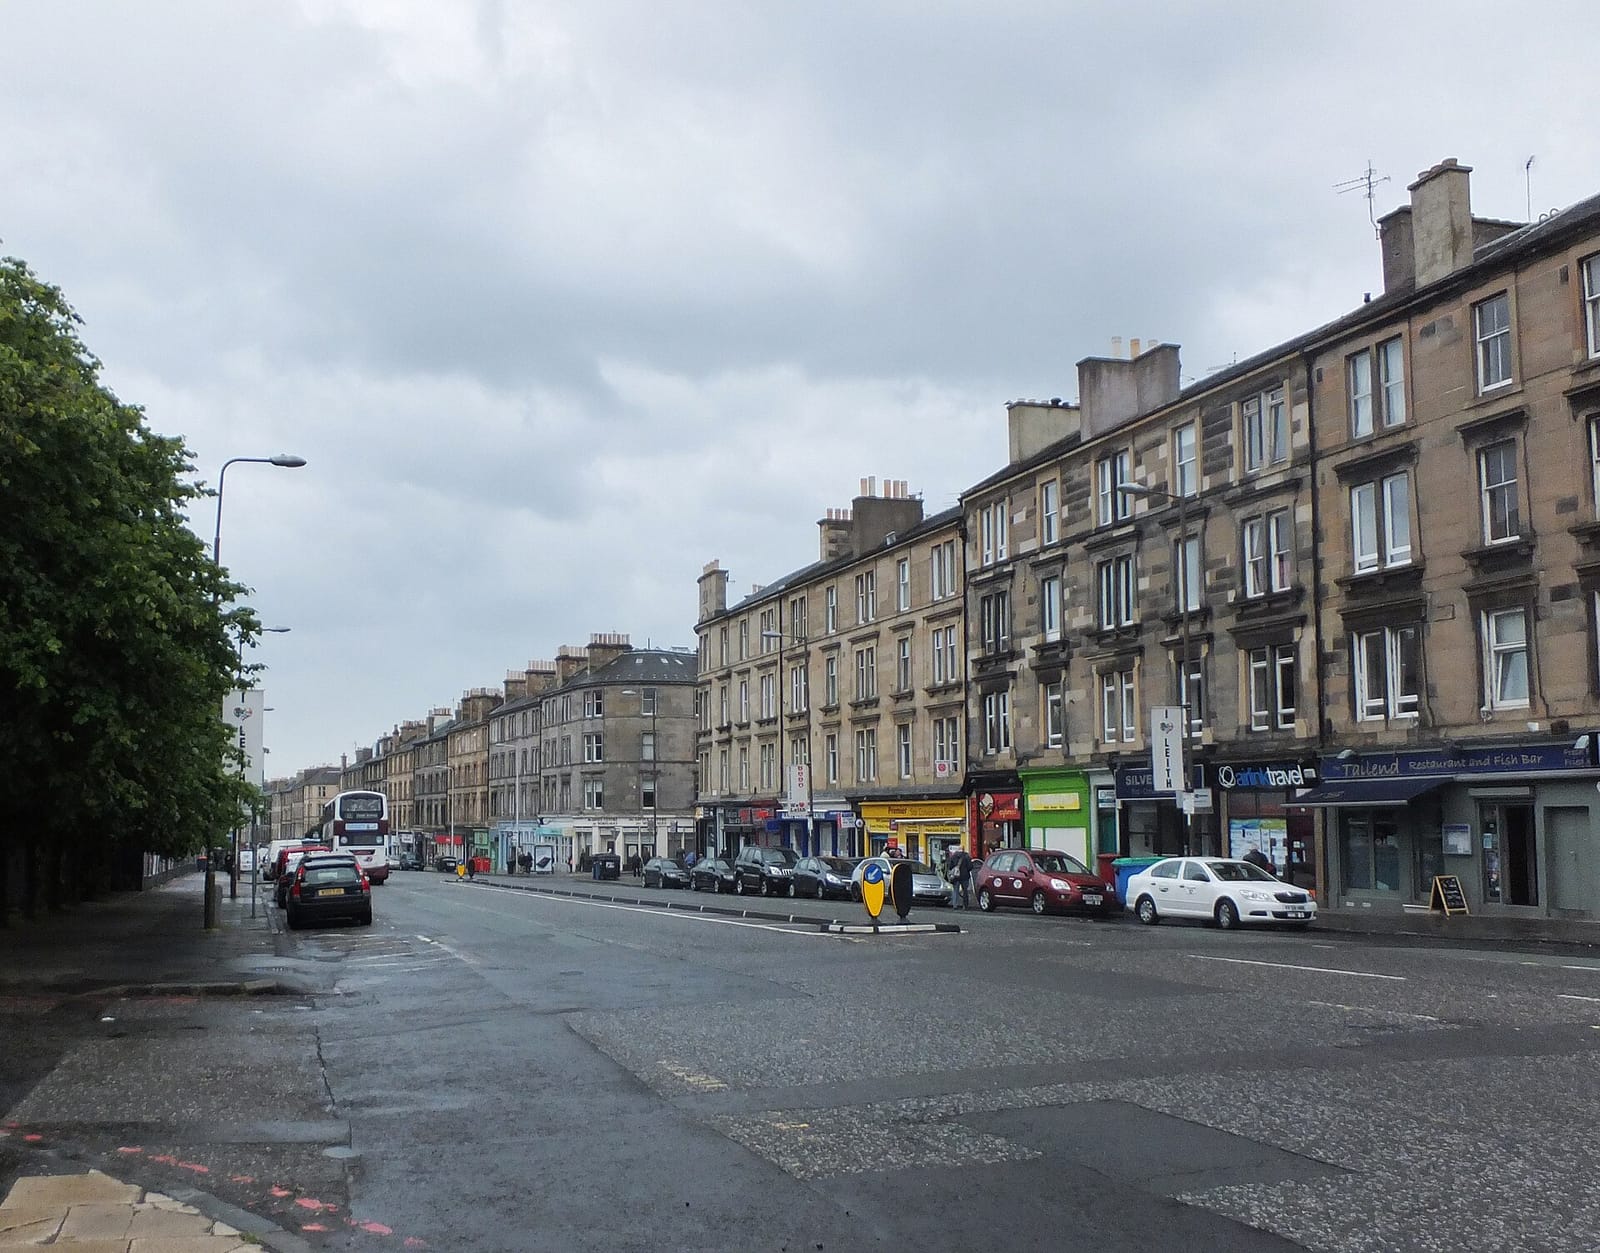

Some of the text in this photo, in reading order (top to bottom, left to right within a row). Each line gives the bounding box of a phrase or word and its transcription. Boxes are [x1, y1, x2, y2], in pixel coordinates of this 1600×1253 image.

[1164, 738, 1173, 788] LEITH
[1341, 752, 1544, 777] Tailend Restaurant and Fish Bar
[1125, 774, 1153, 785] SILVE
